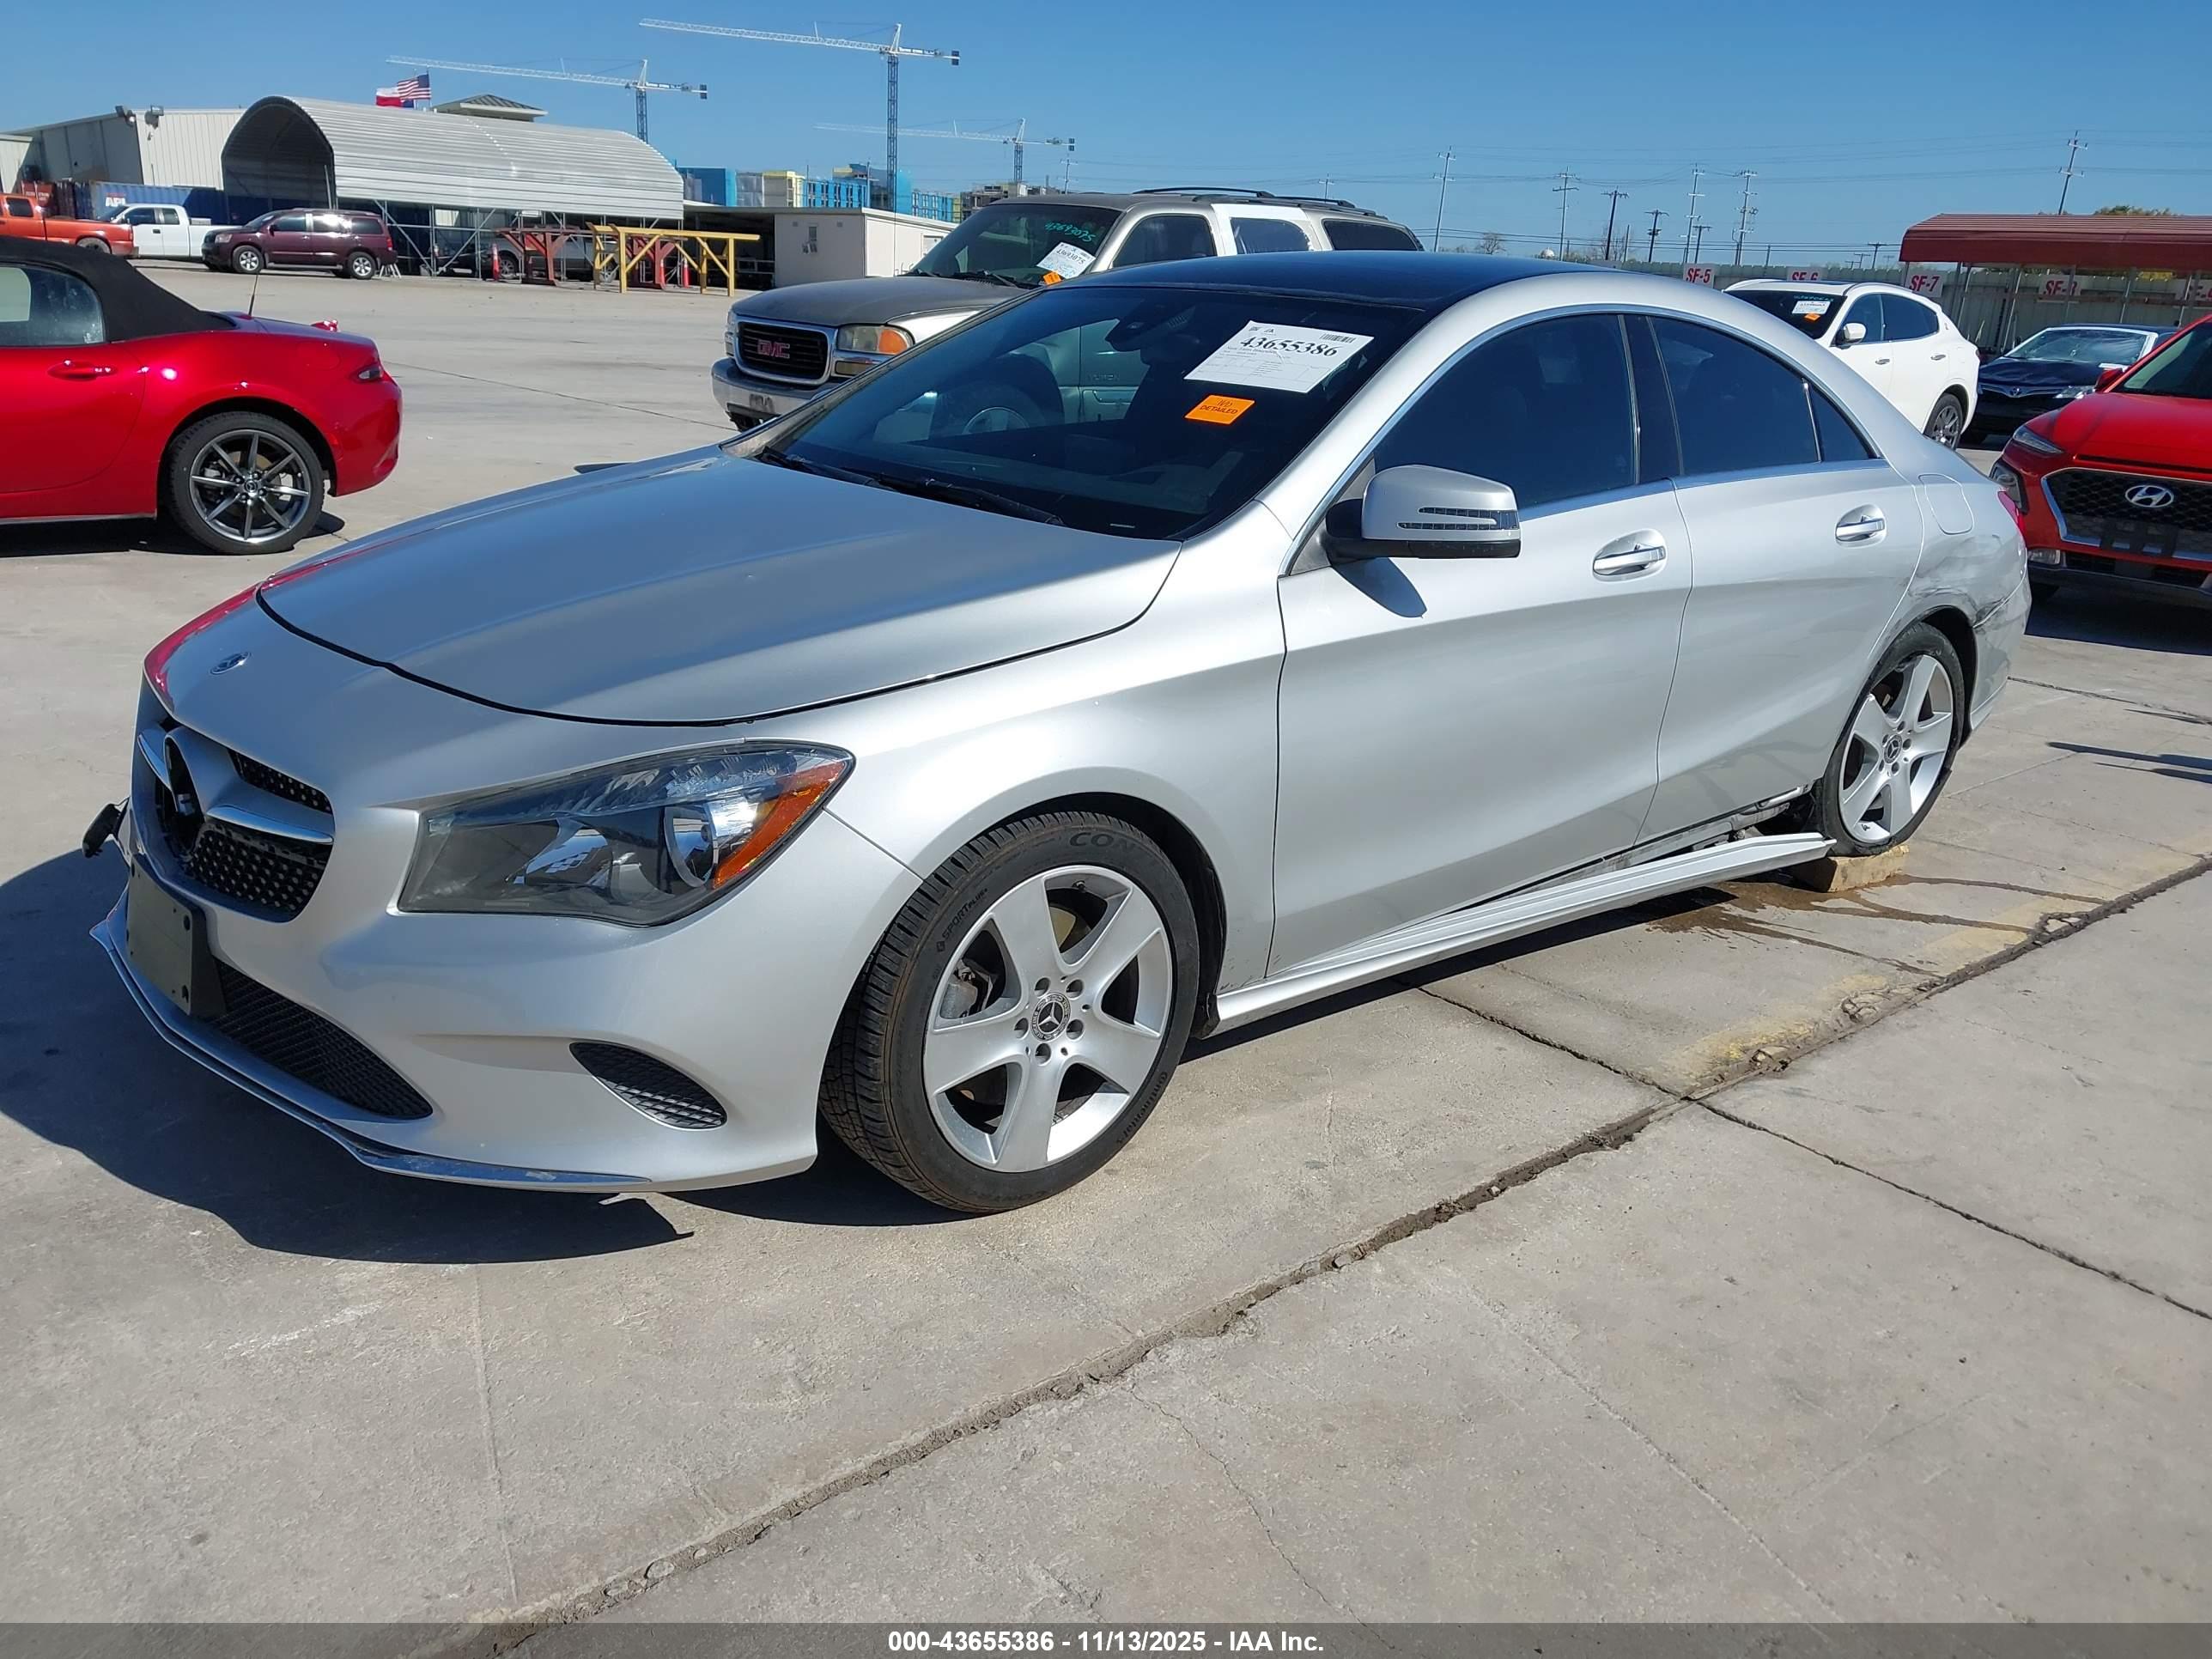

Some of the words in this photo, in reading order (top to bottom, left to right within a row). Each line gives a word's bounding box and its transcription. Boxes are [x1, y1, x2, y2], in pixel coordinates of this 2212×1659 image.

[1686, 267, 1711, 283] SF-5
[1909, 275, 1940, 292] SF-7
[757, 338, 790, 359] GMC
[1240, 336, 1344, 357] 43655386
[1200, 404, 1238, 414] DETAILED
